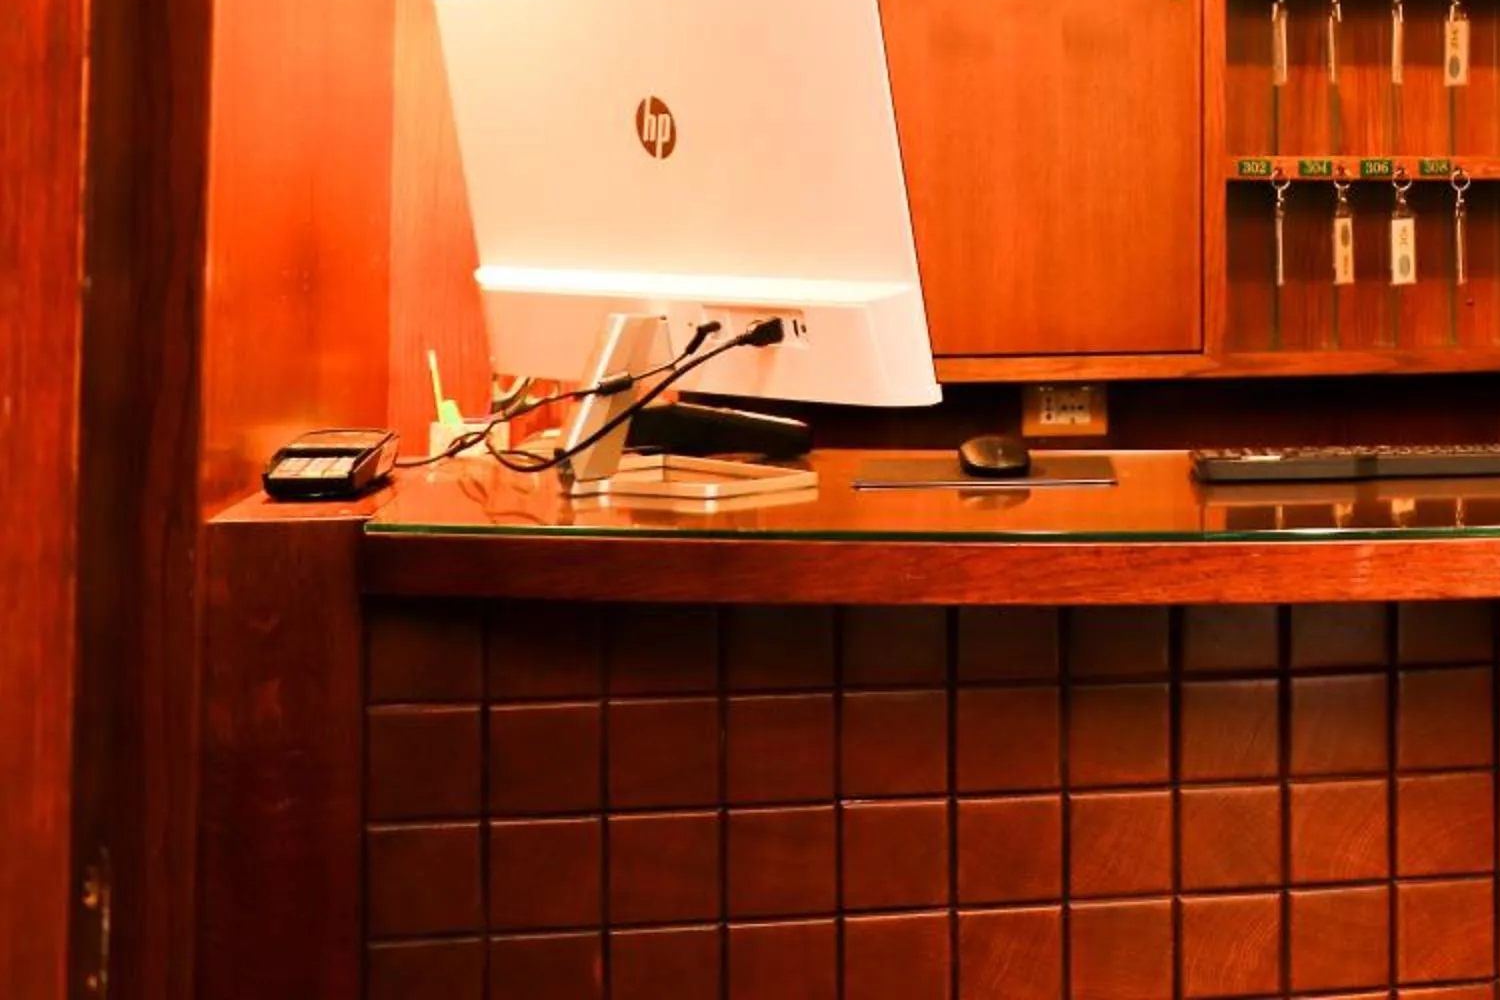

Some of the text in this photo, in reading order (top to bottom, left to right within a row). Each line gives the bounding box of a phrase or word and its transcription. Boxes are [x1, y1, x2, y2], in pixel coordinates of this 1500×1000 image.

[641, 96, 674, 159] hp
[1243, 162, 1267, 174] 302
[1305, 161, 1328, 174] 304
[1365, 161, 1389, 174] 306
[1425, 161, 1449, 173] 308
